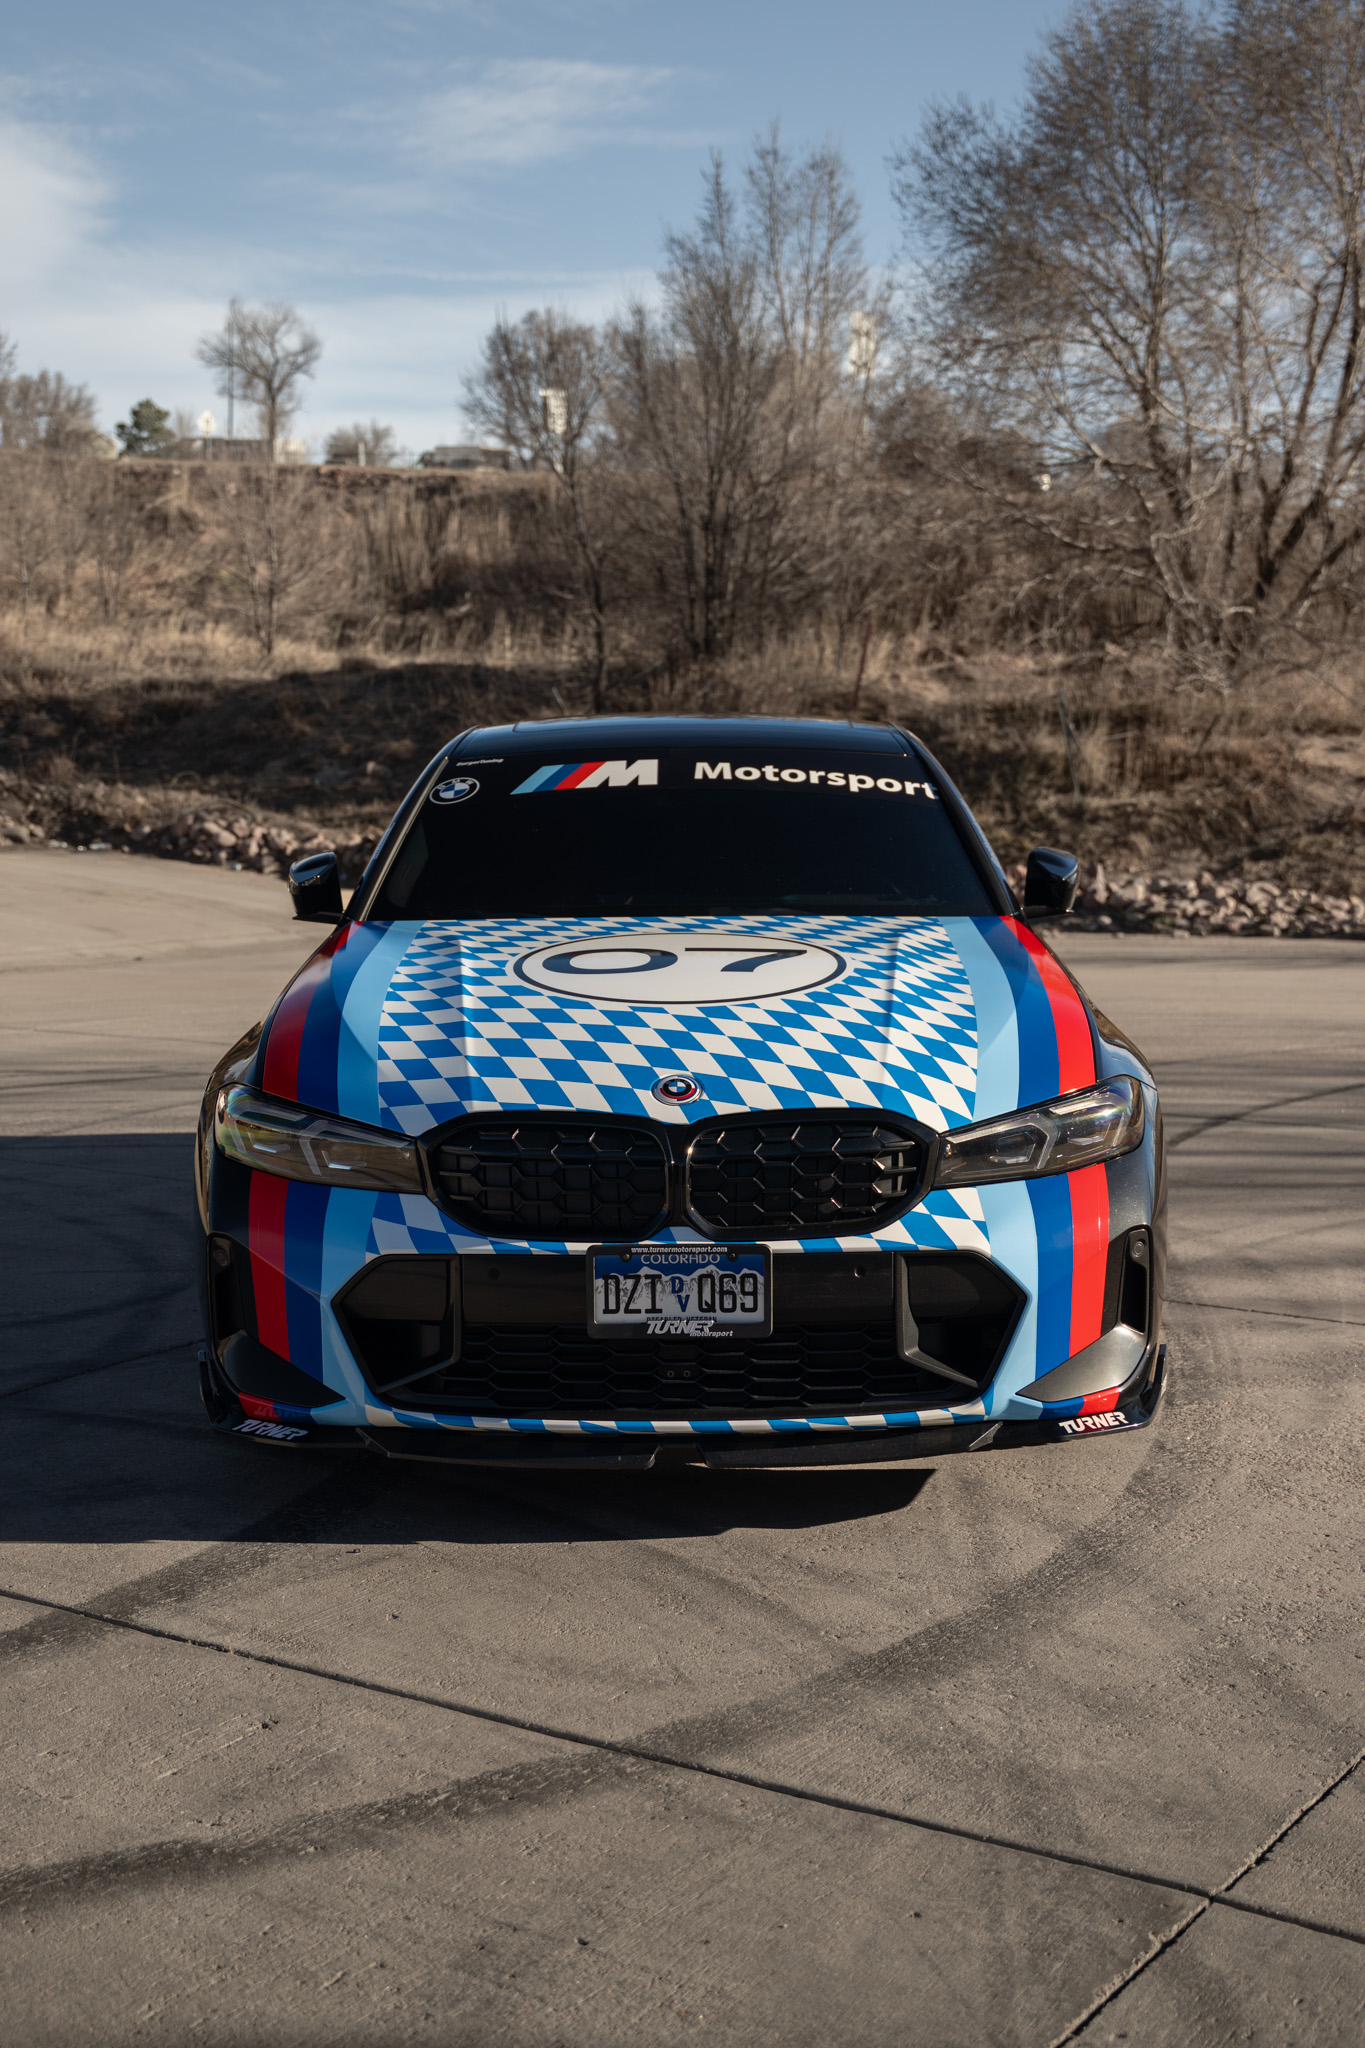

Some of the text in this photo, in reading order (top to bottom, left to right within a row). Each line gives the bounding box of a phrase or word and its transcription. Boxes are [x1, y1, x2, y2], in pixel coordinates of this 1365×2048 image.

[694, 762, 939, 800] Motorsport
[542, 947, 807, 975] 07
[641, 1254, 720, 1264] COLORADO
[602, 1274, 663, 1314] DZI
[698, 1273, 759, 1314] Q69
[646, 1320, 714, 1334] TURNER
[690, 1330, 733, 1338] motorsport
[231, 1418, 309, 1440] TURNER
[1058, 1411, 1129, 1434] TURNER
